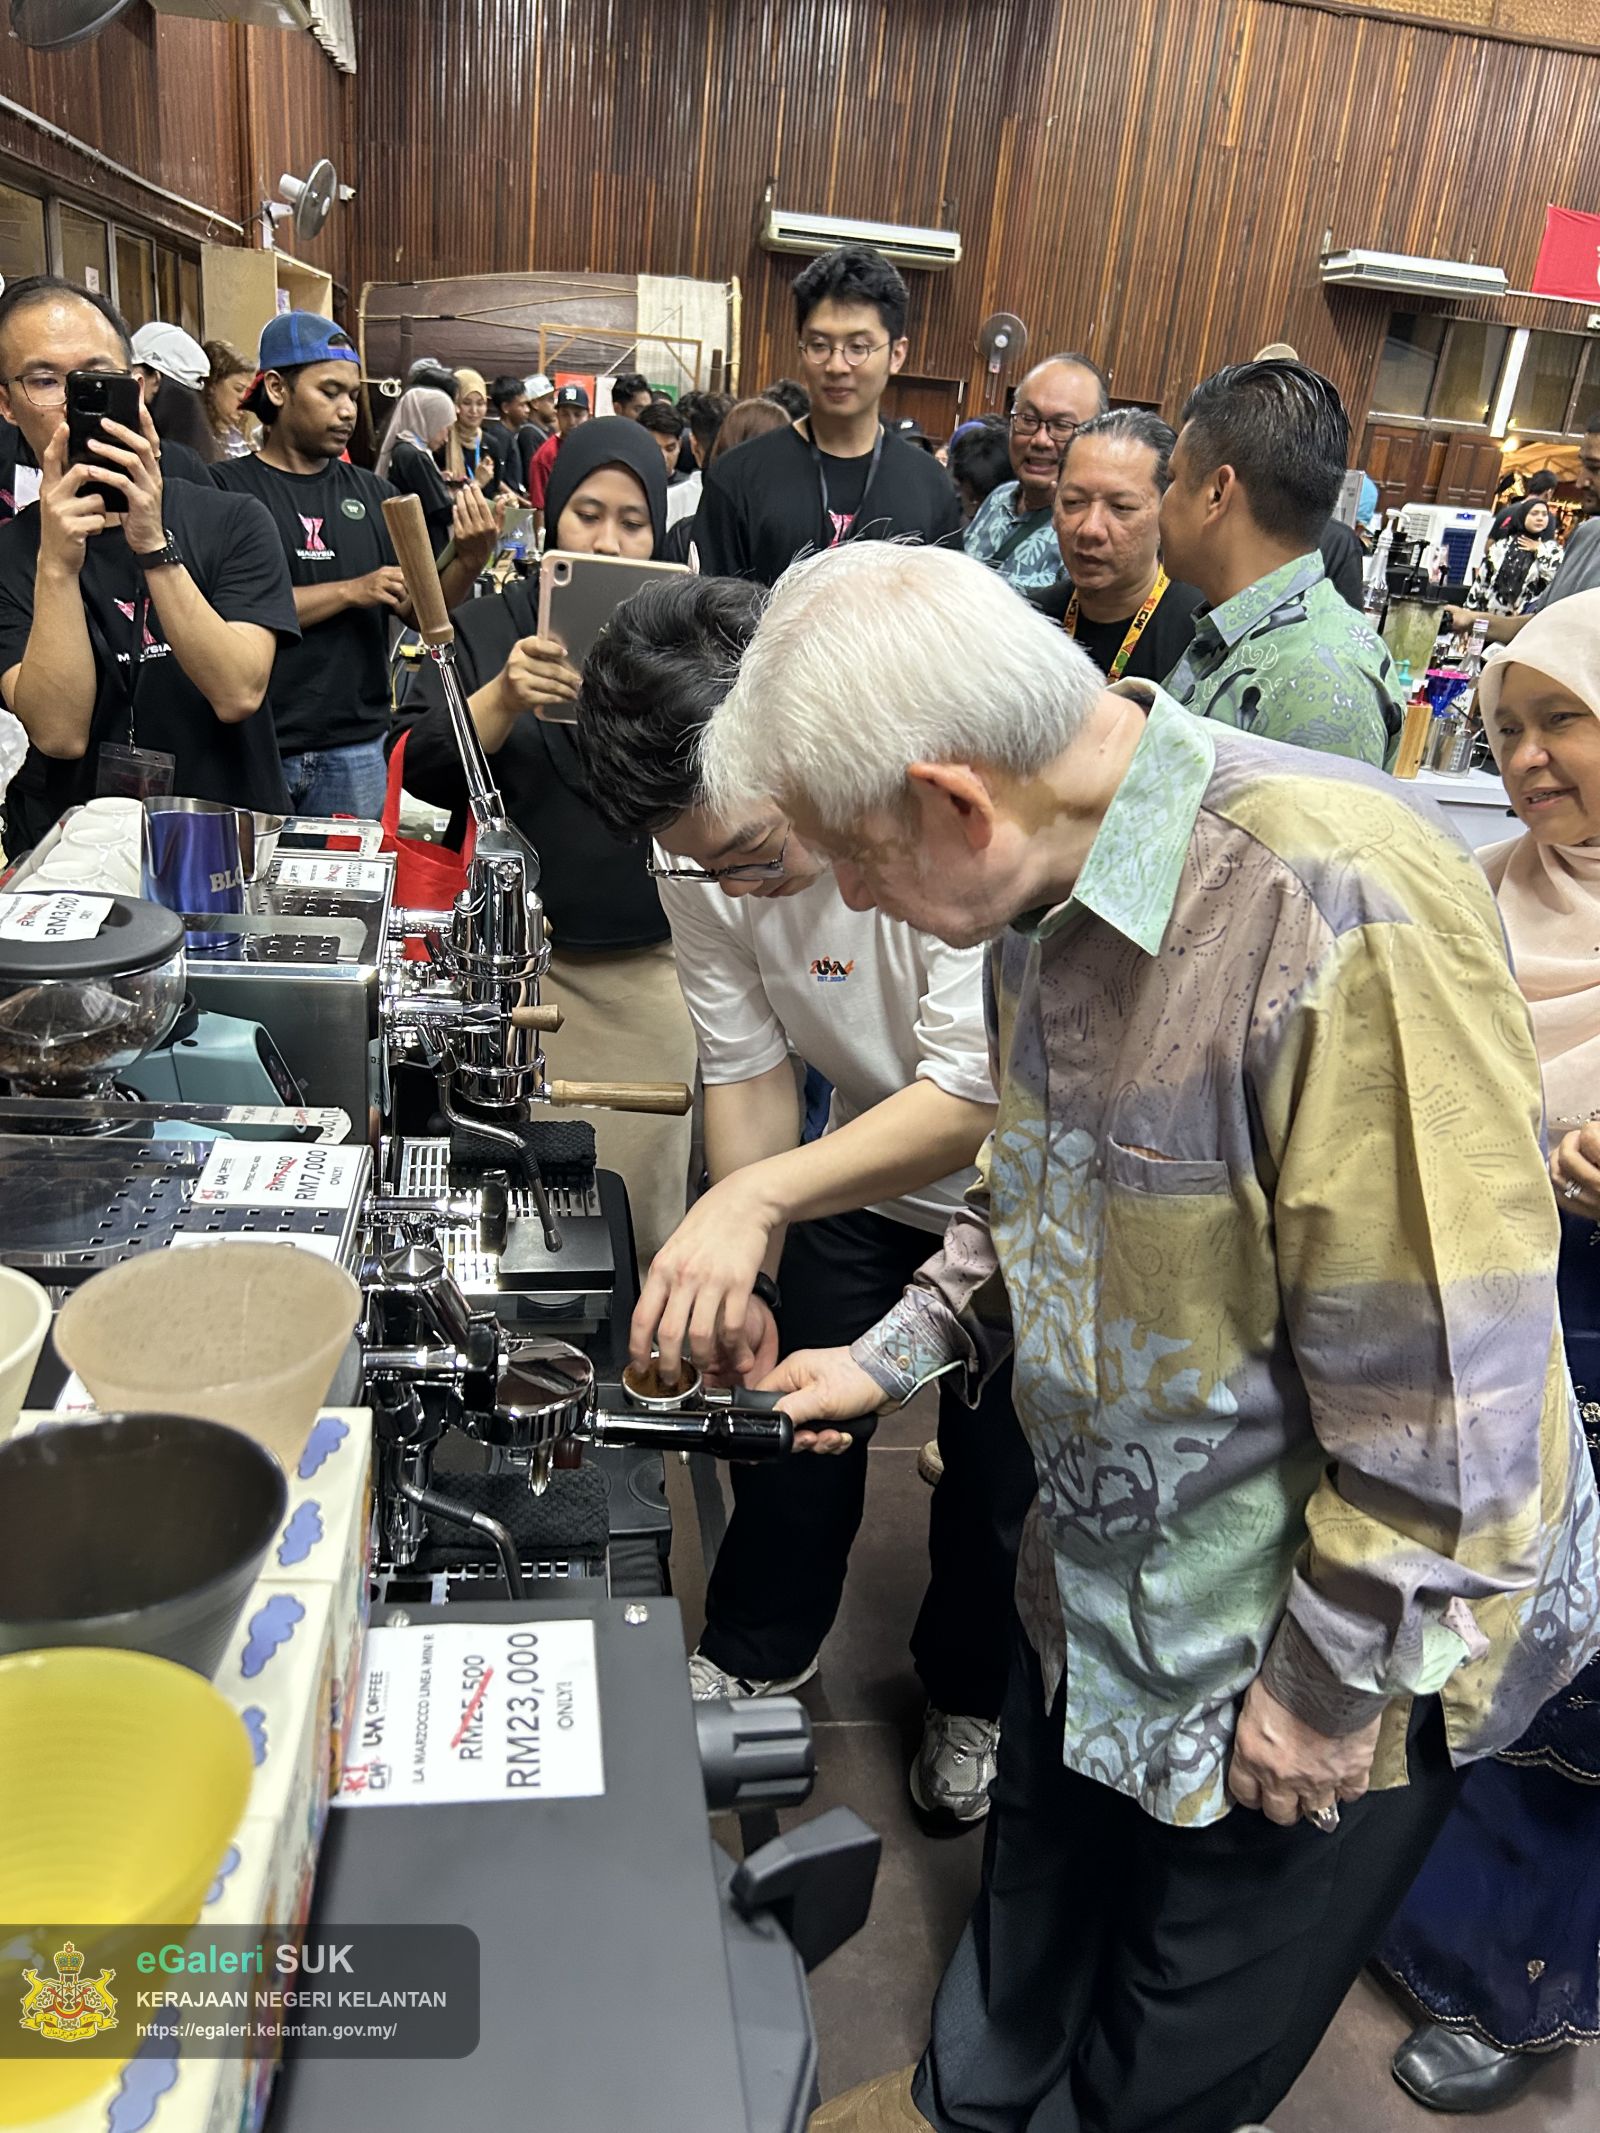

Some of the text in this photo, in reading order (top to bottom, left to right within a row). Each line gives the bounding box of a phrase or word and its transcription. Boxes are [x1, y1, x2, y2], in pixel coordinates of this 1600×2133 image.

[116, 643, 172, 662] MYSIA
[44, 896, 80, 935] RM3,900
[294, 1150, 328, 1200] RM7,000
[422, 1643, 434, 1666] MINI
[366, 1671, 384, 1715] COFFEE
[419, 1667, 432, 1698] LINEA
[506, 1632, 545, 1788] RM23,000
[556, 1681, 575, 1731] ONLY!
[414, 1699, 430, 1765] MARZOCCO
[413, 1767, 425, 1785] LA
